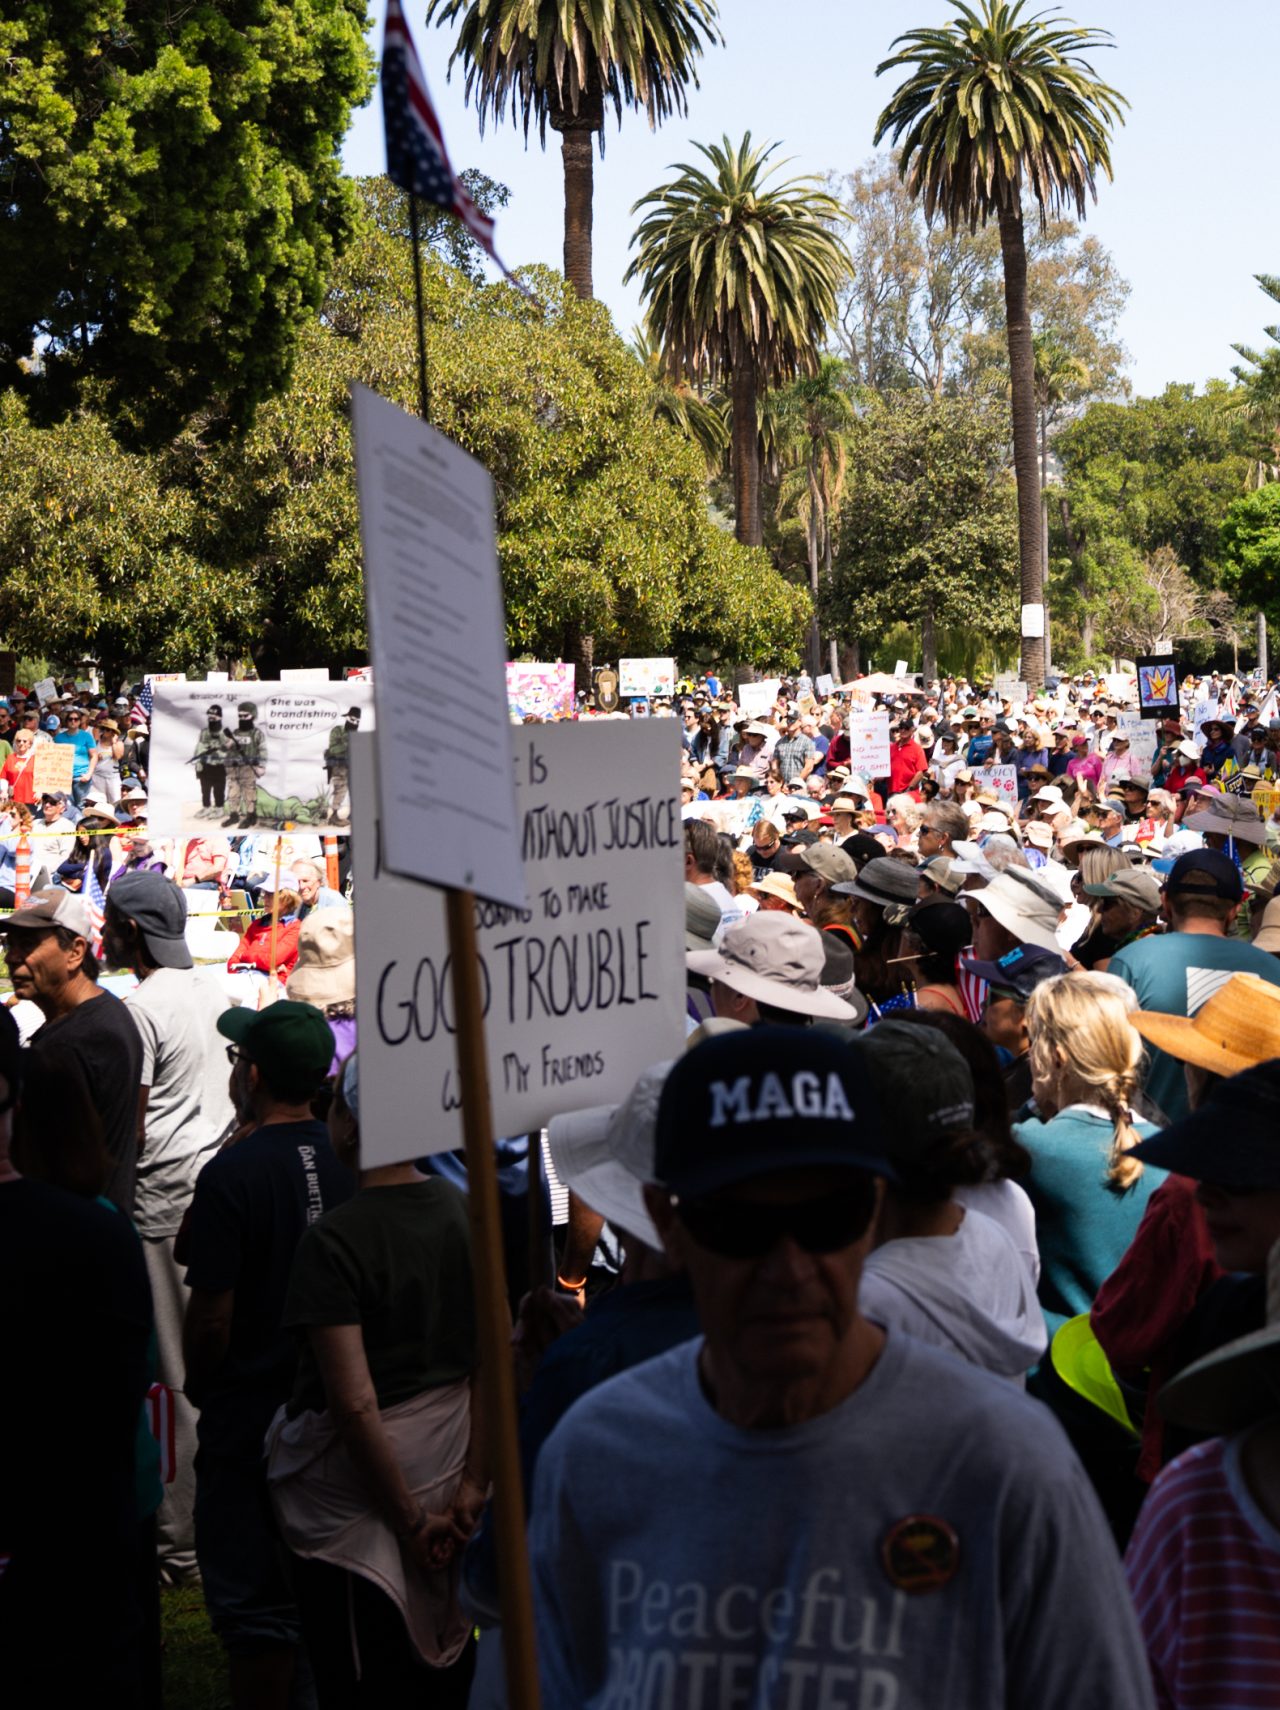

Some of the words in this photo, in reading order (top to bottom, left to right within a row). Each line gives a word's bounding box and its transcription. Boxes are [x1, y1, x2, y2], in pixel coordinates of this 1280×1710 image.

[270, 698, 291, 707] She
[294, 699, 316, 707] was
[270, 709, 338, 719] brandishing
[280, 722, 313, 730] torch!
[1228, 777, 1243, 792] STOP
[603, 797, 680, 850] JUSTICE
[539, 889, 561, 920] TO
[568, 881, 611, 916] MAKE
[494, 920, 659, 1024] TROUBLE
[541, 1044, 605, 1089] FRIENDS
[709, 1070, 856, 1128] MAGA
[297, 1145, 316, 1170] DAN
[607, 1559, 907, 1659] Peaceful
